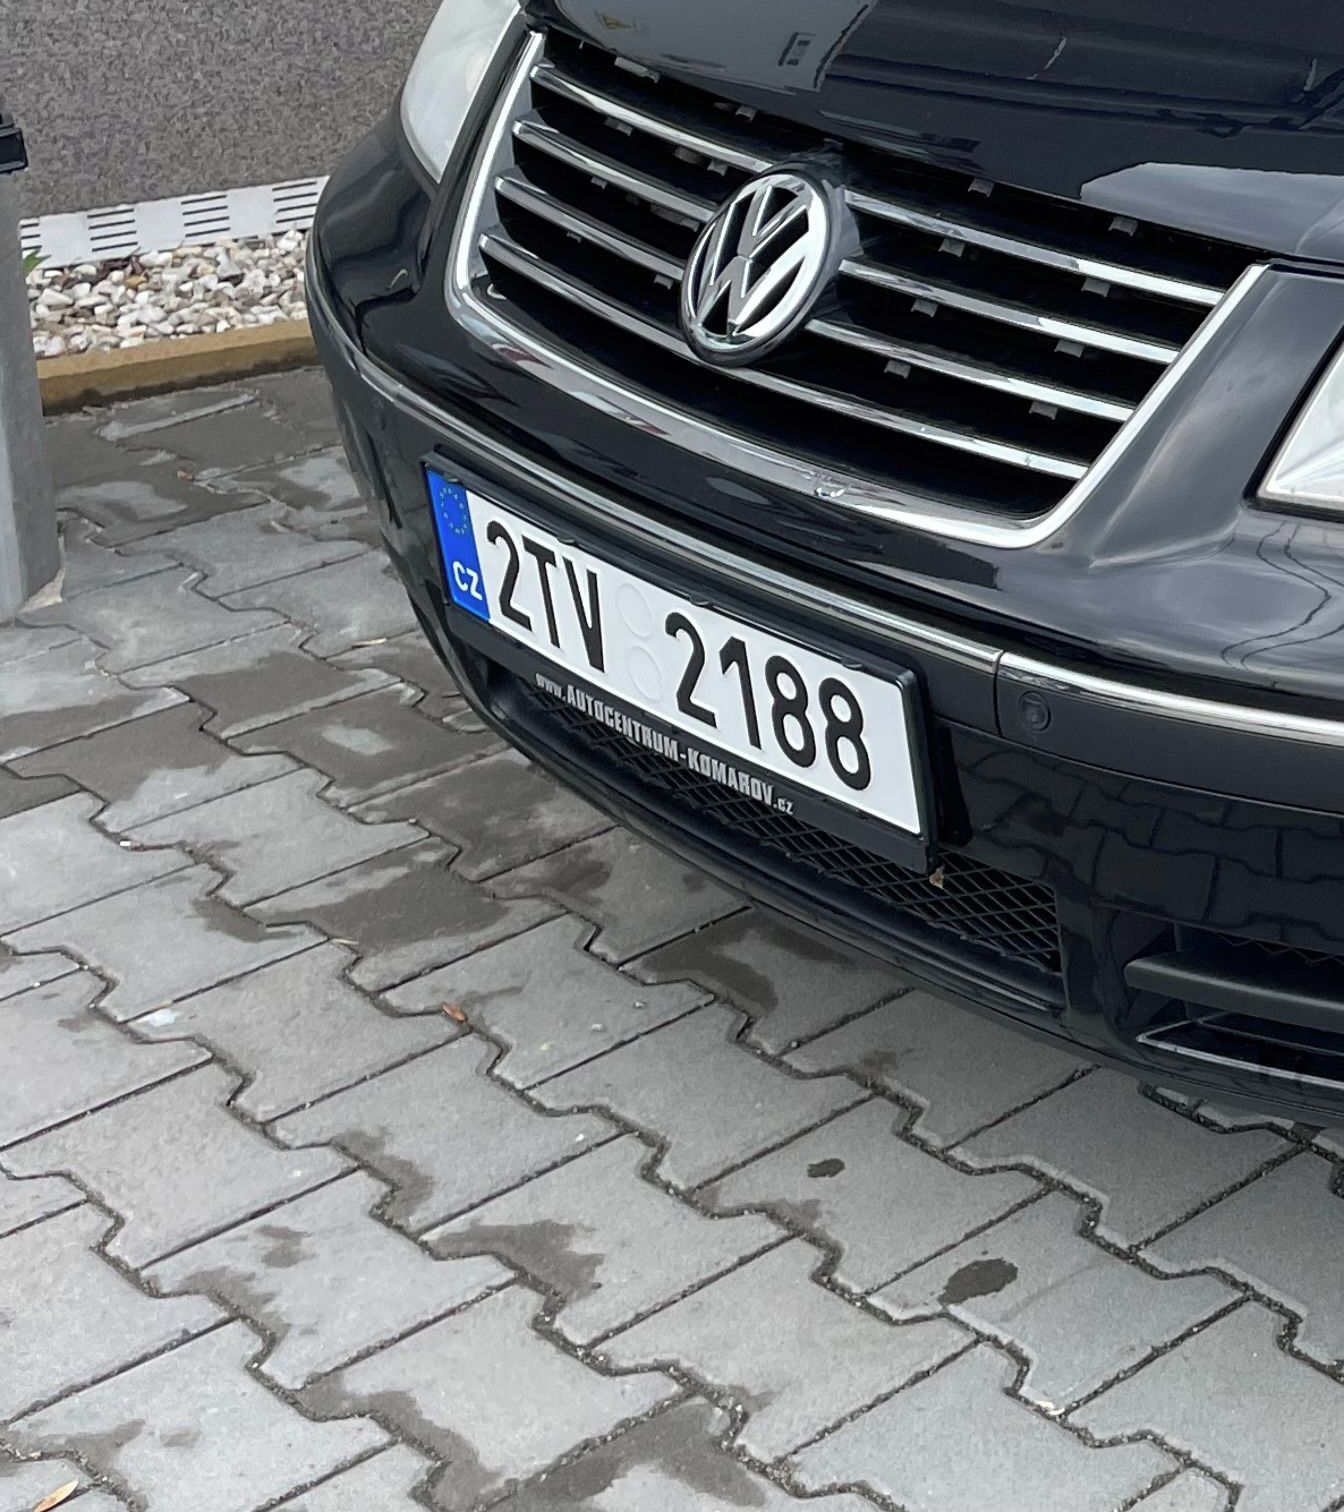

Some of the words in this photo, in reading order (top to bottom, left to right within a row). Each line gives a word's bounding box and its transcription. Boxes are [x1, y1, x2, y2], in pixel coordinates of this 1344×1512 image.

[452, 561, 483, 601] CZ
[487, 520, 606, 673] 2TV
[665, 611, 872, 791] 2188
